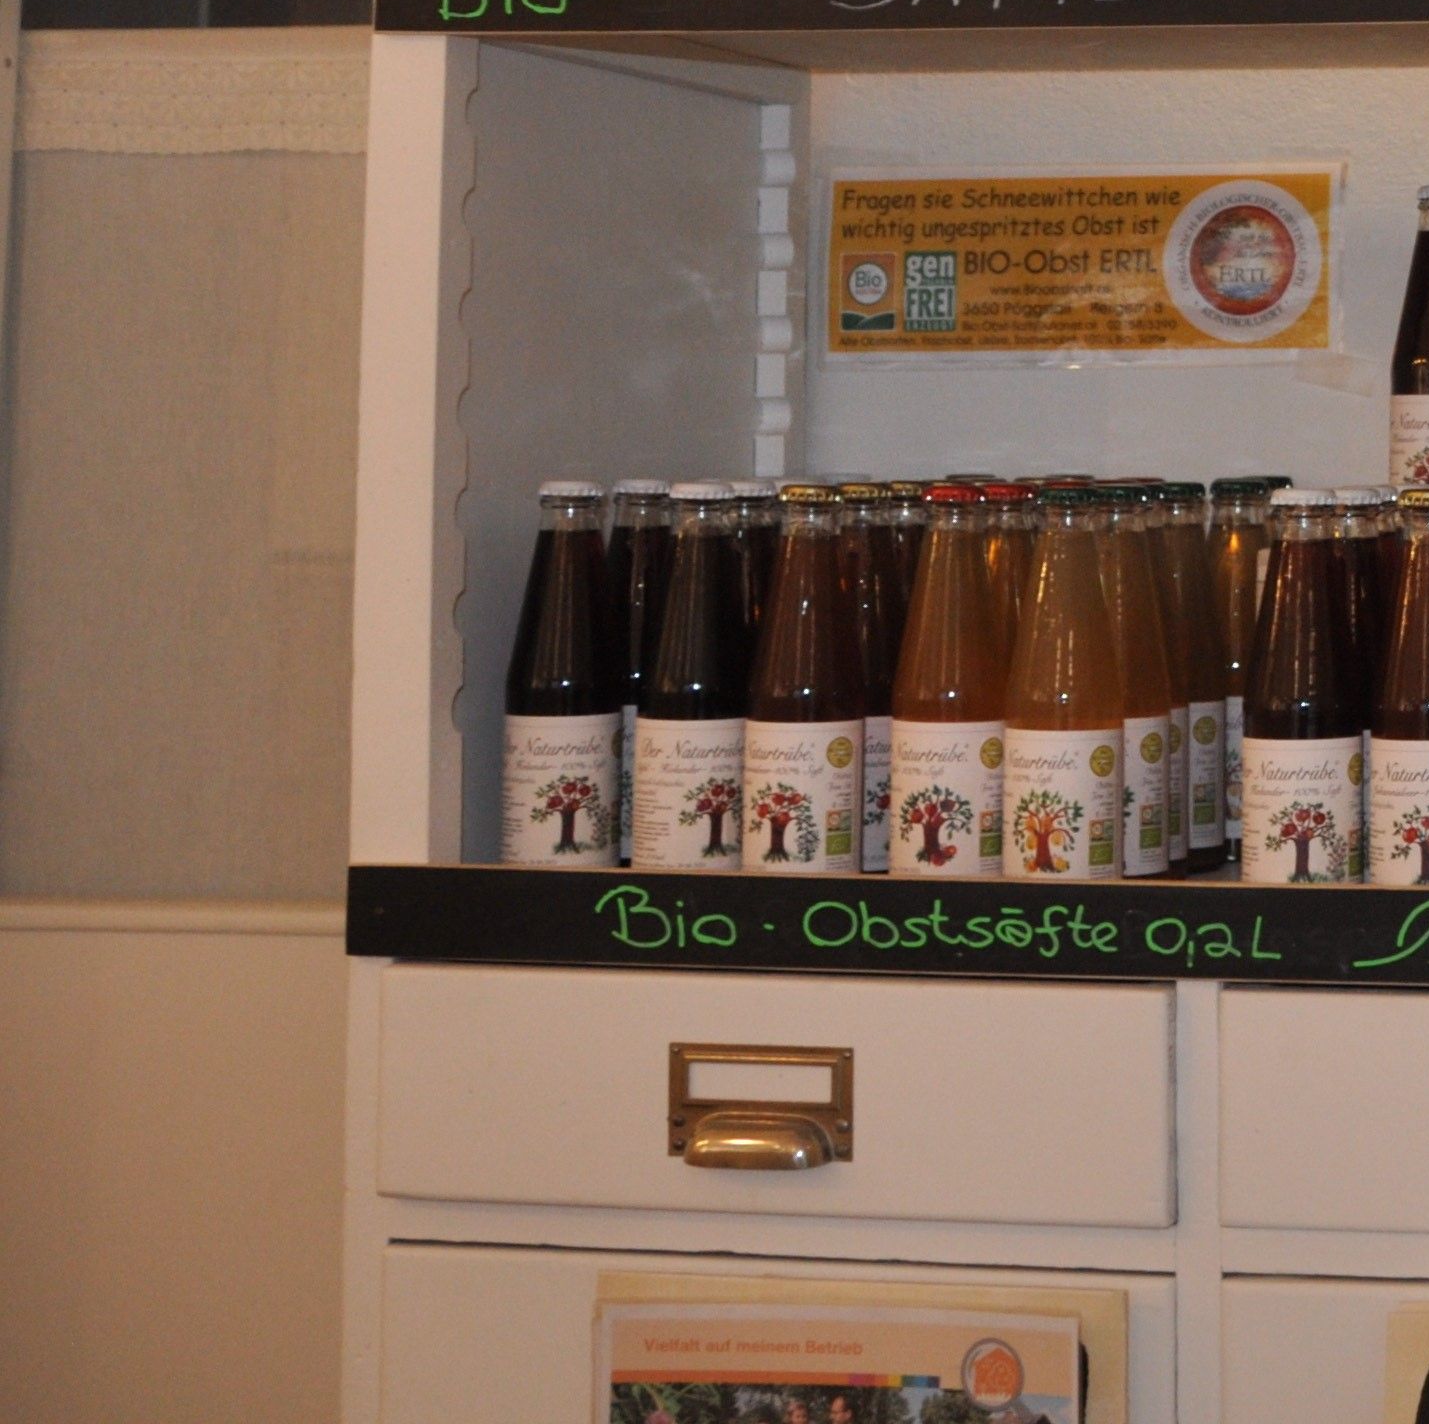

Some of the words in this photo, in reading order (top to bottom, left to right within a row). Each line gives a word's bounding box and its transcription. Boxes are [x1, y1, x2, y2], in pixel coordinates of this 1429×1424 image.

[841, 189, 916, 215] Fragen
[924, 190, 952, 208] sie
[962, 187, 1138, 208] Schneewittchen
[1145, 188, 1180, 206] wie
[842, 219, 914, 245] wichtig
[922, 216, 1064, 242] ungespritztes
[1072, 216, 1125, 237] Obst
[1134, 216, 1160, 235] ist
[906, 255, 953, 287] gen
[964, 249, 1090, 275] BIO-Obst
[1100, 249, 1157, 274] ERTL
[1219, 264, 1270, 282] ERTL
[855, 270, 881, 287] Bio
[907, 290, 952, 317] FREI
[596, 885, 736, 949] Bio
[802, 897, 1119, 958] Obstsäfte
[644, 1338, 700, 1355] Vielfalt
[705, 1339, 731, 1354] auf
[805, 1340, 864, 1356] Betrieb
